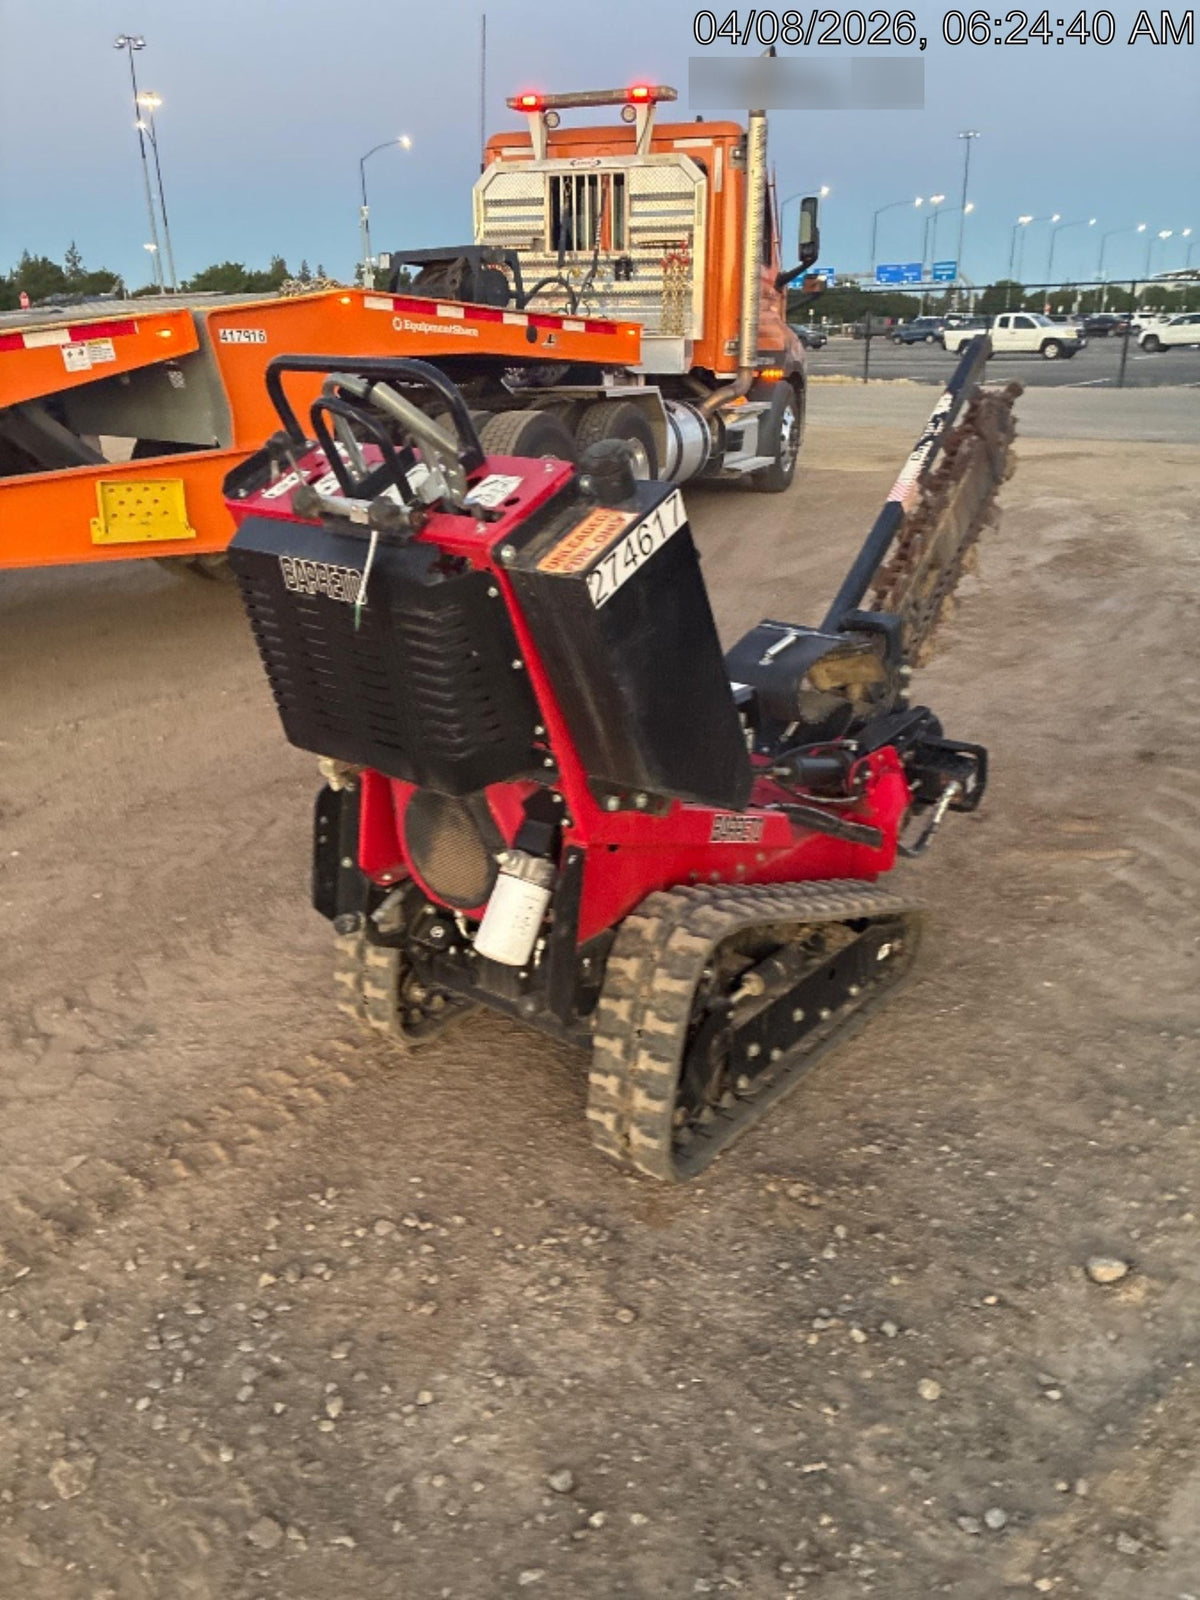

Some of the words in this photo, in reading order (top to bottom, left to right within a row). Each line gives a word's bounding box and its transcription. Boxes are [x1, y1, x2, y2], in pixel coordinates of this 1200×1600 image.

[221, 329, 266, 342] 417916
[404, 319, 479, 337] EquipmentShare
[546, 514, 610, 570] UNLEADED
[594, 516, 627, 544] ONLY
[588, 493, 678, 605] 274617
